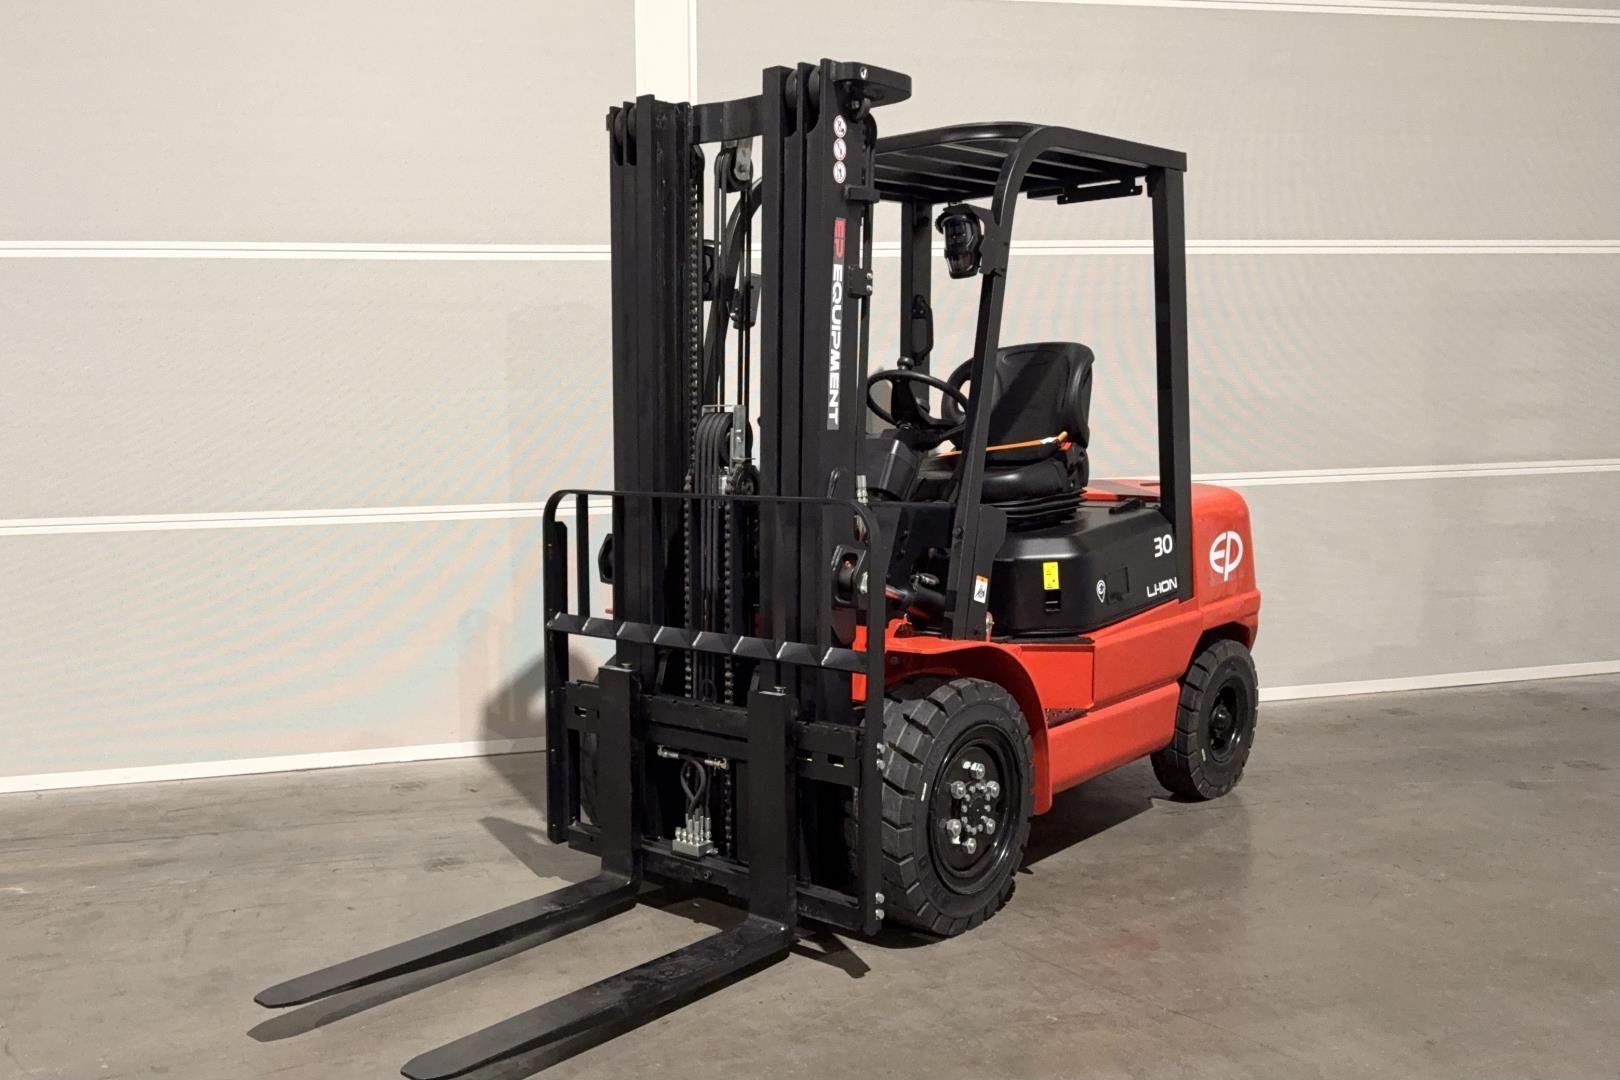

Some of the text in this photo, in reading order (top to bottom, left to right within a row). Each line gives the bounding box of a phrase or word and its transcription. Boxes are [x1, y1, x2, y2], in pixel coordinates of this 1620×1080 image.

[828, 218, 846, 425] EP EQUIPMENT
[1153, 534, 1173, 558] 30
